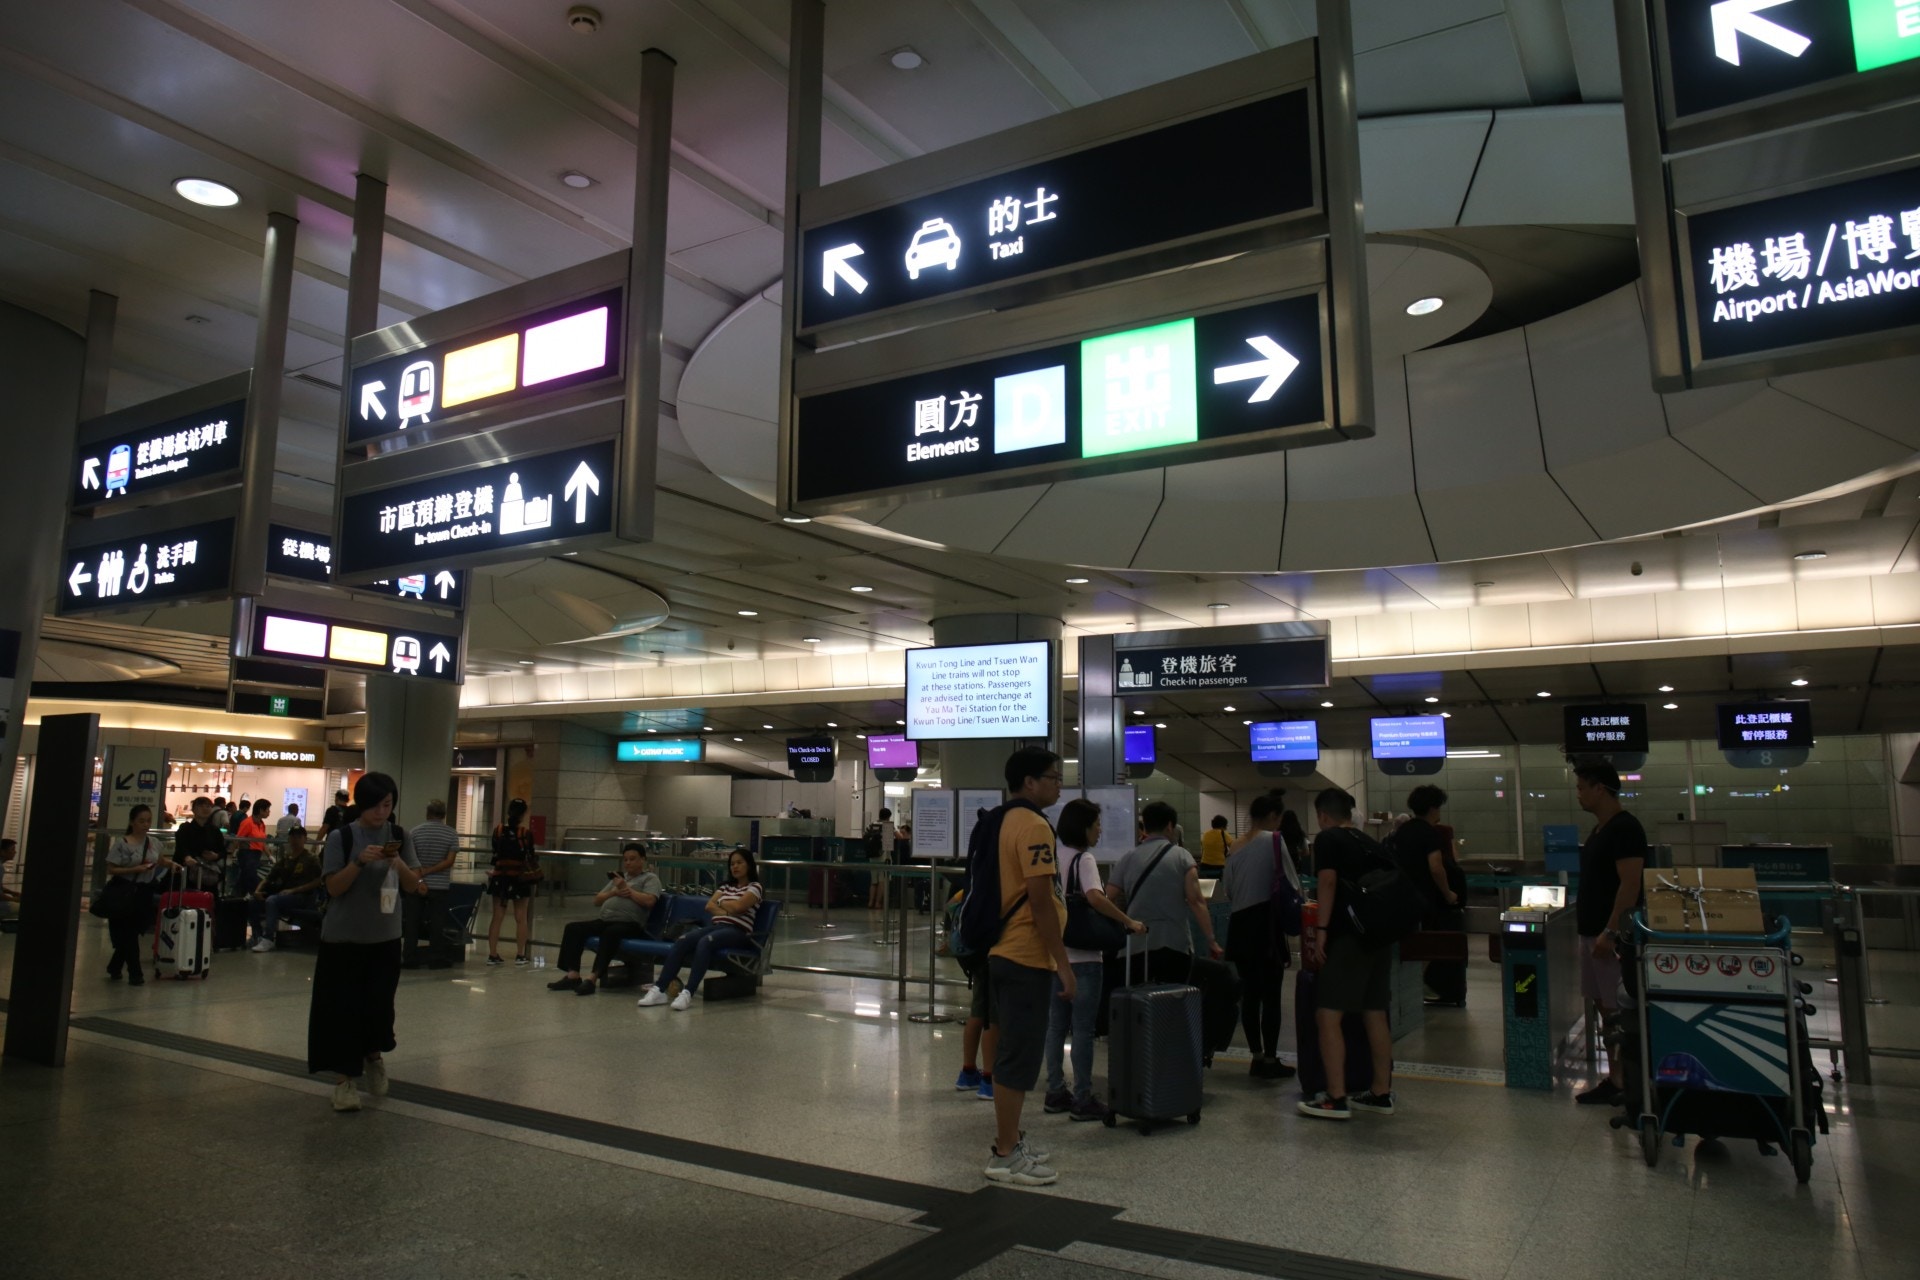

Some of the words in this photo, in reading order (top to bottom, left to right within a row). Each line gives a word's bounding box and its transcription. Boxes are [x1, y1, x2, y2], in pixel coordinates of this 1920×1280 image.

[989, 187, 1058, 236] 的士
[989, 236, 1023, 260] Taxi
[1713, 290, 1797, 322] Airport
[915, 390, 983, 437] 圓方
[1012, 383, 1052, 437] D
[1106, 405, 1169, 436] EXIT
[907, 436, 980, 462] Elements
[379, 485, 494, 533] 市區預辦登機
[415, 529, 451, 546] In-town
[451, 520, 492, 539] Check-in
[916, 661, 937, 669] Kwun
[939, 660, 958, 669] Tong
[960, 659, 975, 667] Line
[977, 657, 992, 666] and
[994, 657, 1018, 665] Tsuen
[1019, 656, 1038, 664] Wan
[1161, 653, 1237, 675] 登機旅客
[932, 672, 947, 680] Line
[949, 671, 970, 679] trains
[972, 669, 985, 678] will
[1002, 669, 1020, 677] stop
[1160, 676, 1197, 686] Check-in
[1198, 676, 1248, 687] passengers
[921, 684, 929, 692] at
[931, 682, 951, 691] these
[953, 681, 986, 690] stations.
[988, 680, 1031, 689] Passengers
[920, 695, 932, 703] are
[934, 693, 963, 702] advised
[965, 693, 974, 701] to
[975, 691, 1022, 702] interchange
[925, 705, 940, 714] Yau
[941, 705, 953, 713] Ma
[956, 704, 968, 713] Tei
[969, 703, 997, 713] Station
[999, 703, 1011, 712] for
[1013, 703, 1027, 711] the
[913, 717, 934, 725] Kwun
[936, 717, 955, 726] Tong
[1001, 715, 1019, 723] Wan
[1021, 714, 1040, 723] Line.
[1586, 731, 1626, 742] 暫停服務
[1741, 730, 1788, 741] 暫停服務
[253, 750, 279, 760] TONG
[280, 751, 299, 761] BAO
[300, 753, 316, 762] DIM
[1760, 750, 1773, 766] 8
[1282, 763, 1291, 776] 5
[1405, 760, 1416, 773] 6
[1028, 843, 1053, 866] 73
